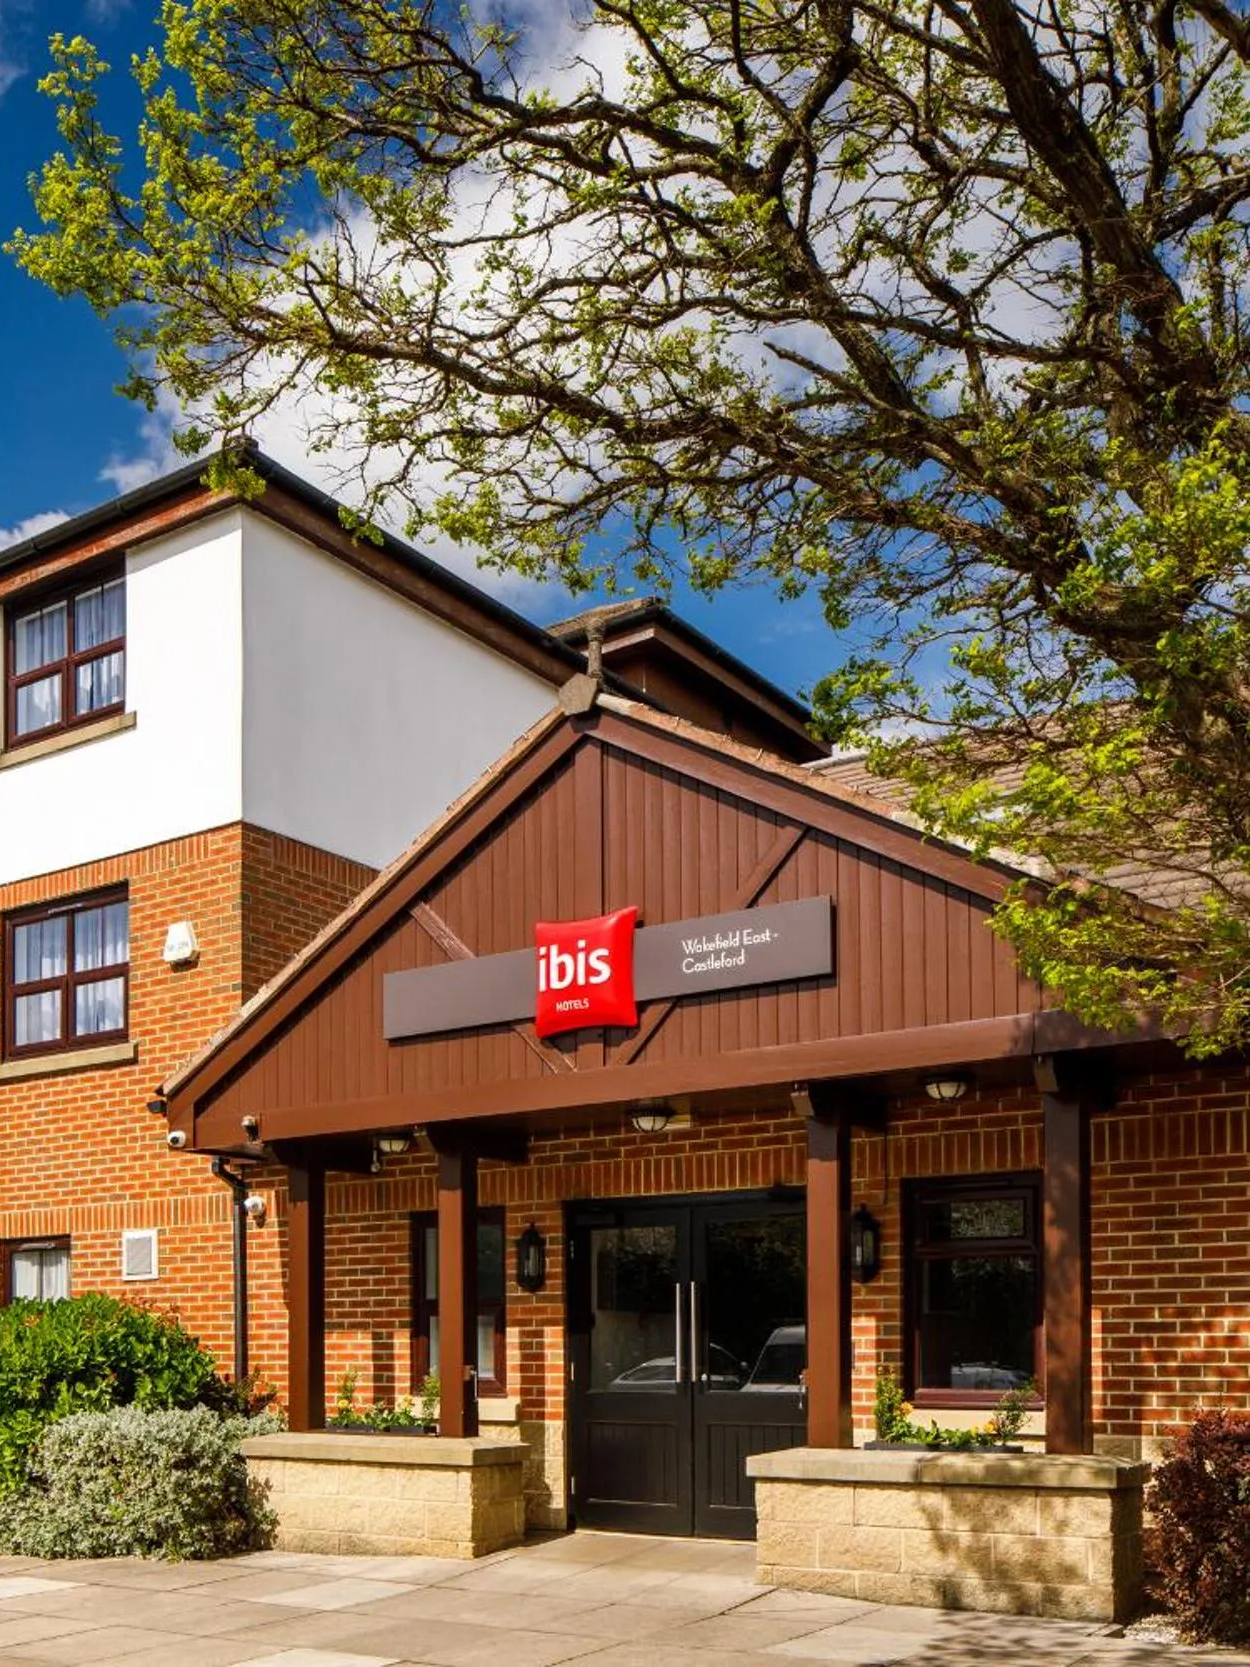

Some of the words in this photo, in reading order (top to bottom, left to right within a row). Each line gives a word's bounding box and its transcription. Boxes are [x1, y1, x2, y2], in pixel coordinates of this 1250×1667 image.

[682, 931, 740, 954] Wakefield
[743, 928, 770, 945] East
[539, 939, 611, 992] ibis
[682, 948, 745, 973] Castleford
[556, 998, 590, 1012] HOTELS
